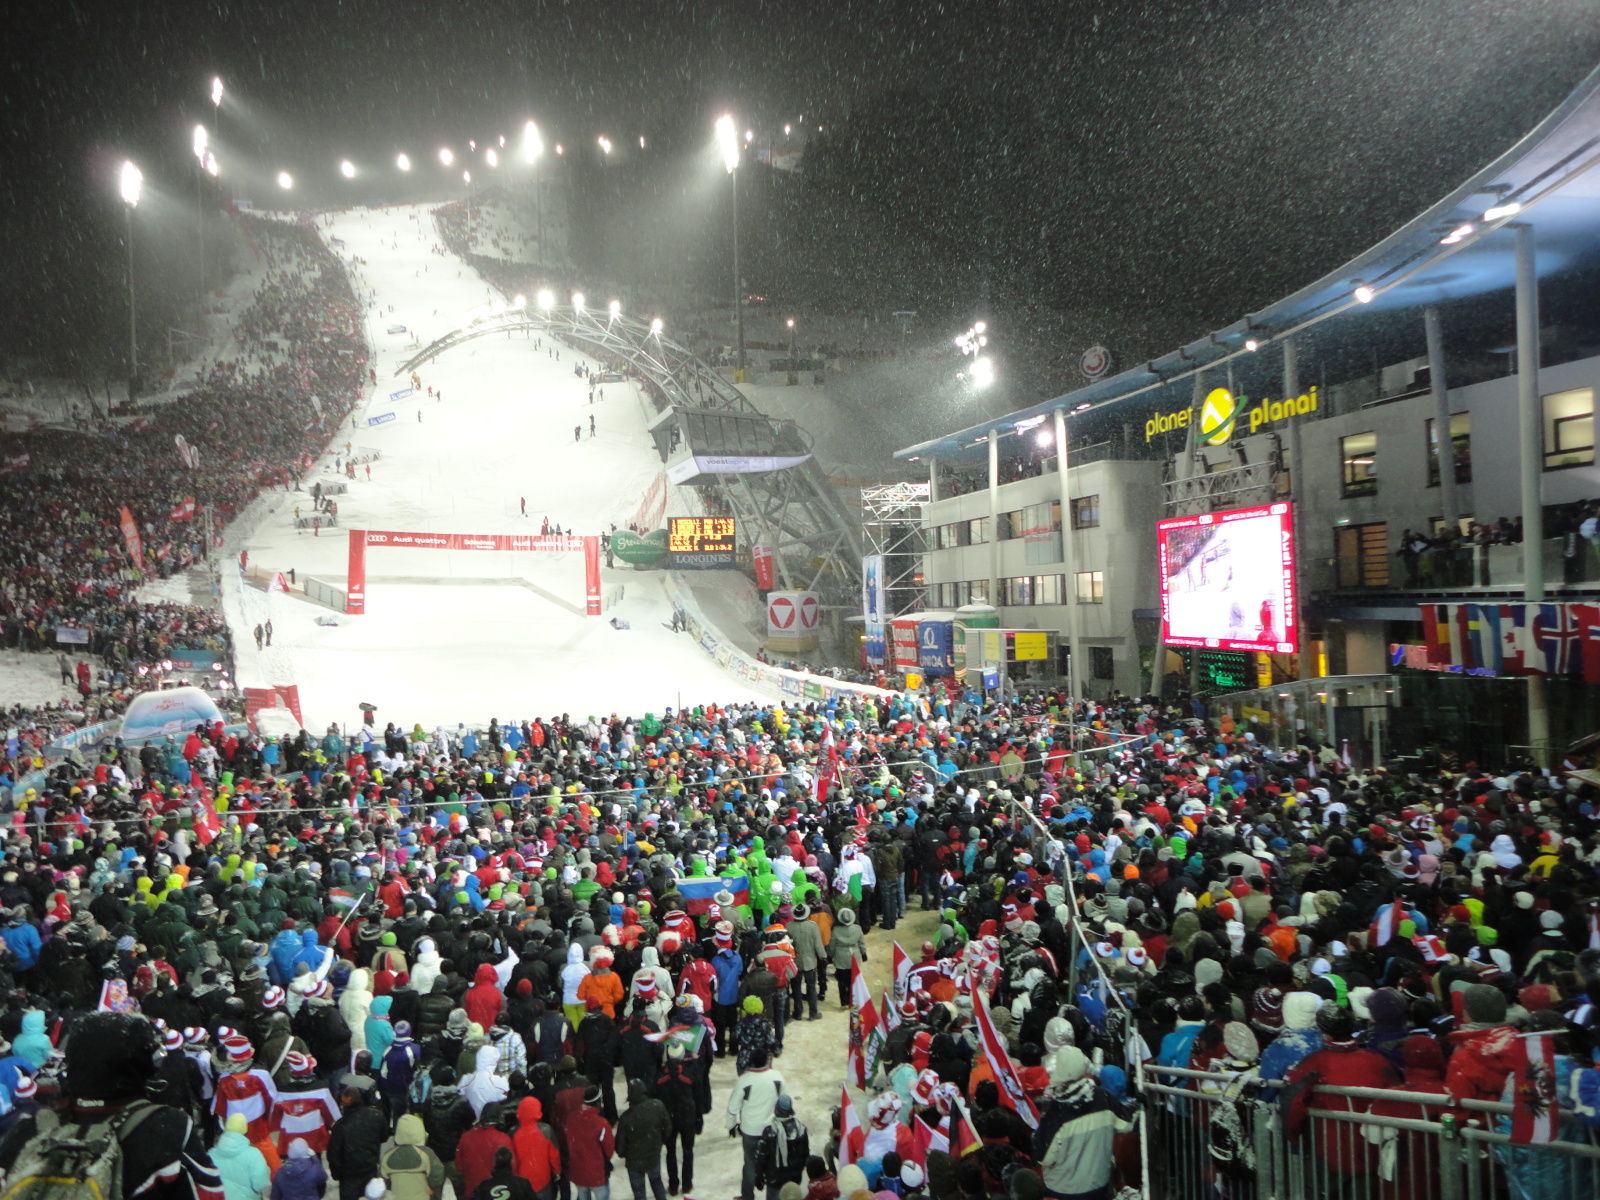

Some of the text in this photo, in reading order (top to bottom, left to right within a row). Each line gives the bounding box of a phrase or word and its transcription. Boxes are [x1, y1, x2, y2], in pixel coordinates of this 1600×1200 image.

[1145, 385, 1318, 443] planet planai
[393, 535, 447, 545] Audi quattro
[512, 539, 530, 547] Audi
[675, 554, 732, 564] LONGINES
[920, 654, 944, 668] UNIQA
